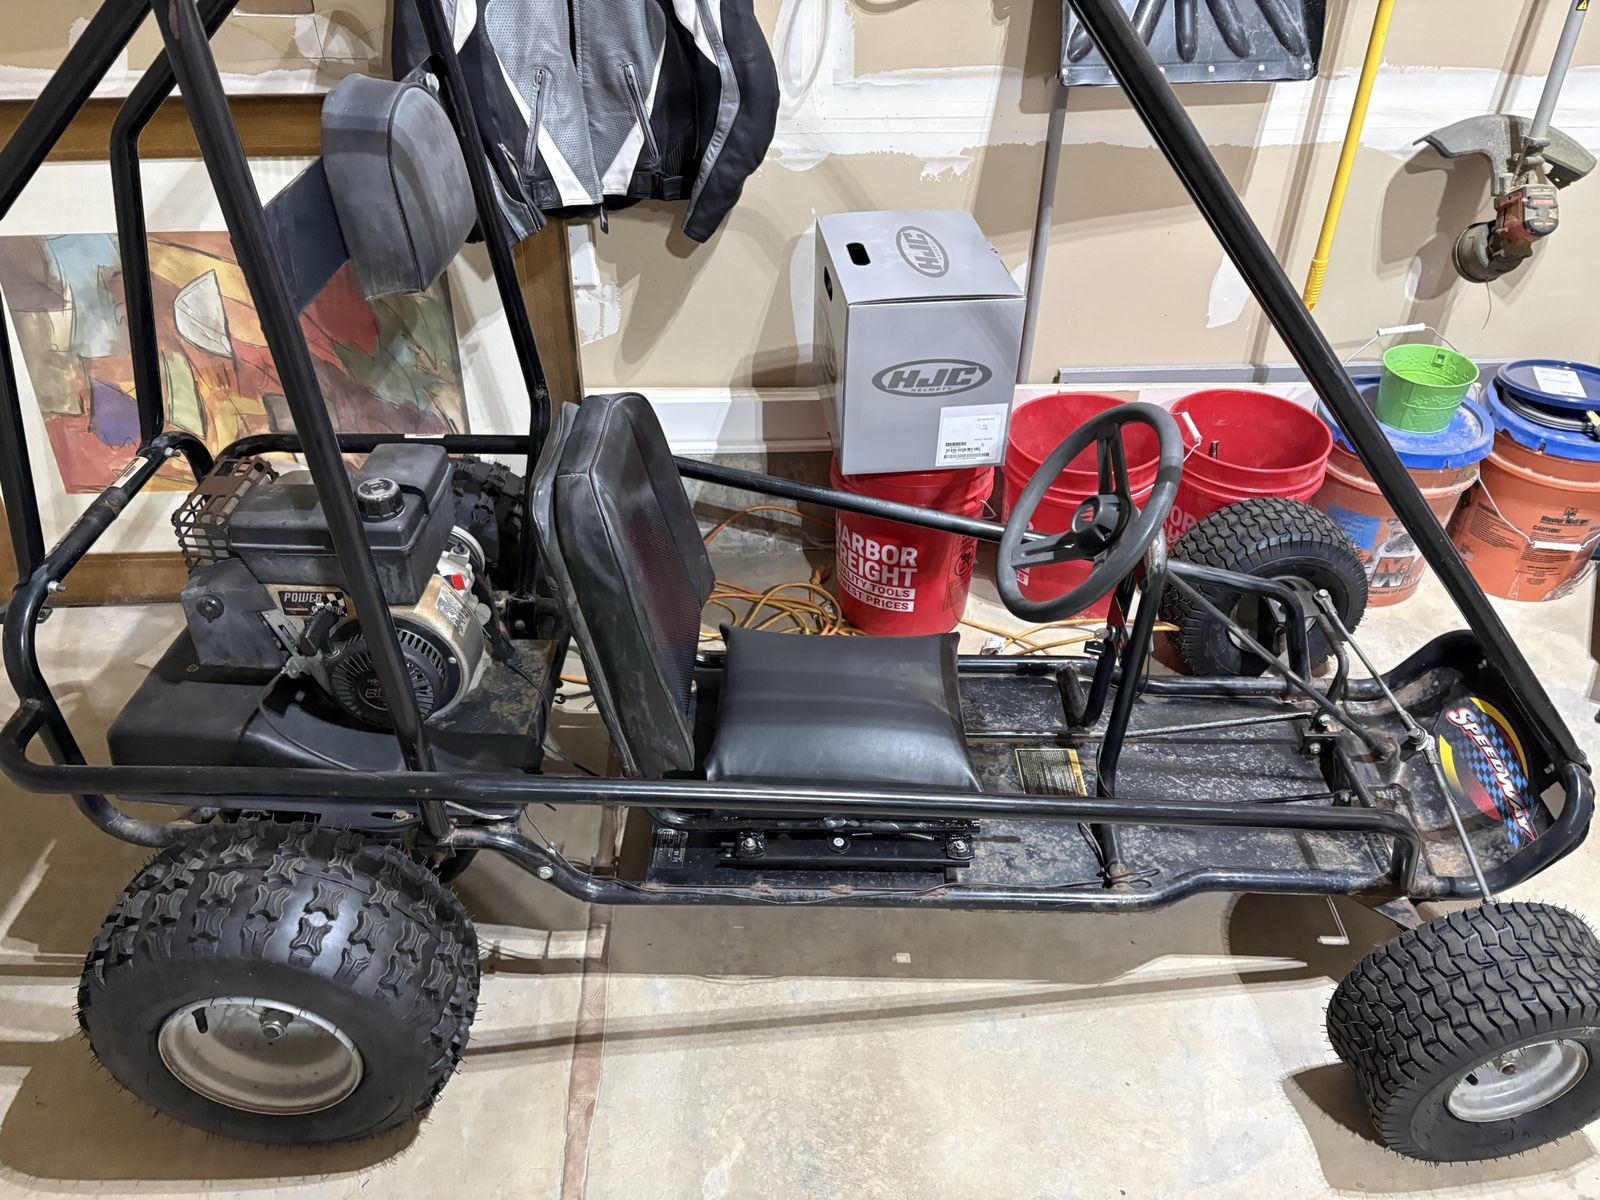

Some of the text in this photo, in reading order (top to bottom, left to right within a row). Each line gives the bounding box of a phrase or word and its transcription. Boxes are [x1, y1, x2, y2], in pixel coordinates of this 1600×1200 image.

[902, 232, 943, 270] HJC
[887, 367, 979, 389] HJC
[284, 592, 323, 603] POWER
[839, 577, 909, 611] WEST PRICES
[870, 583, 910, 598] TOOLS
[1446, 708, 1536, 840] SPEEDWAY
